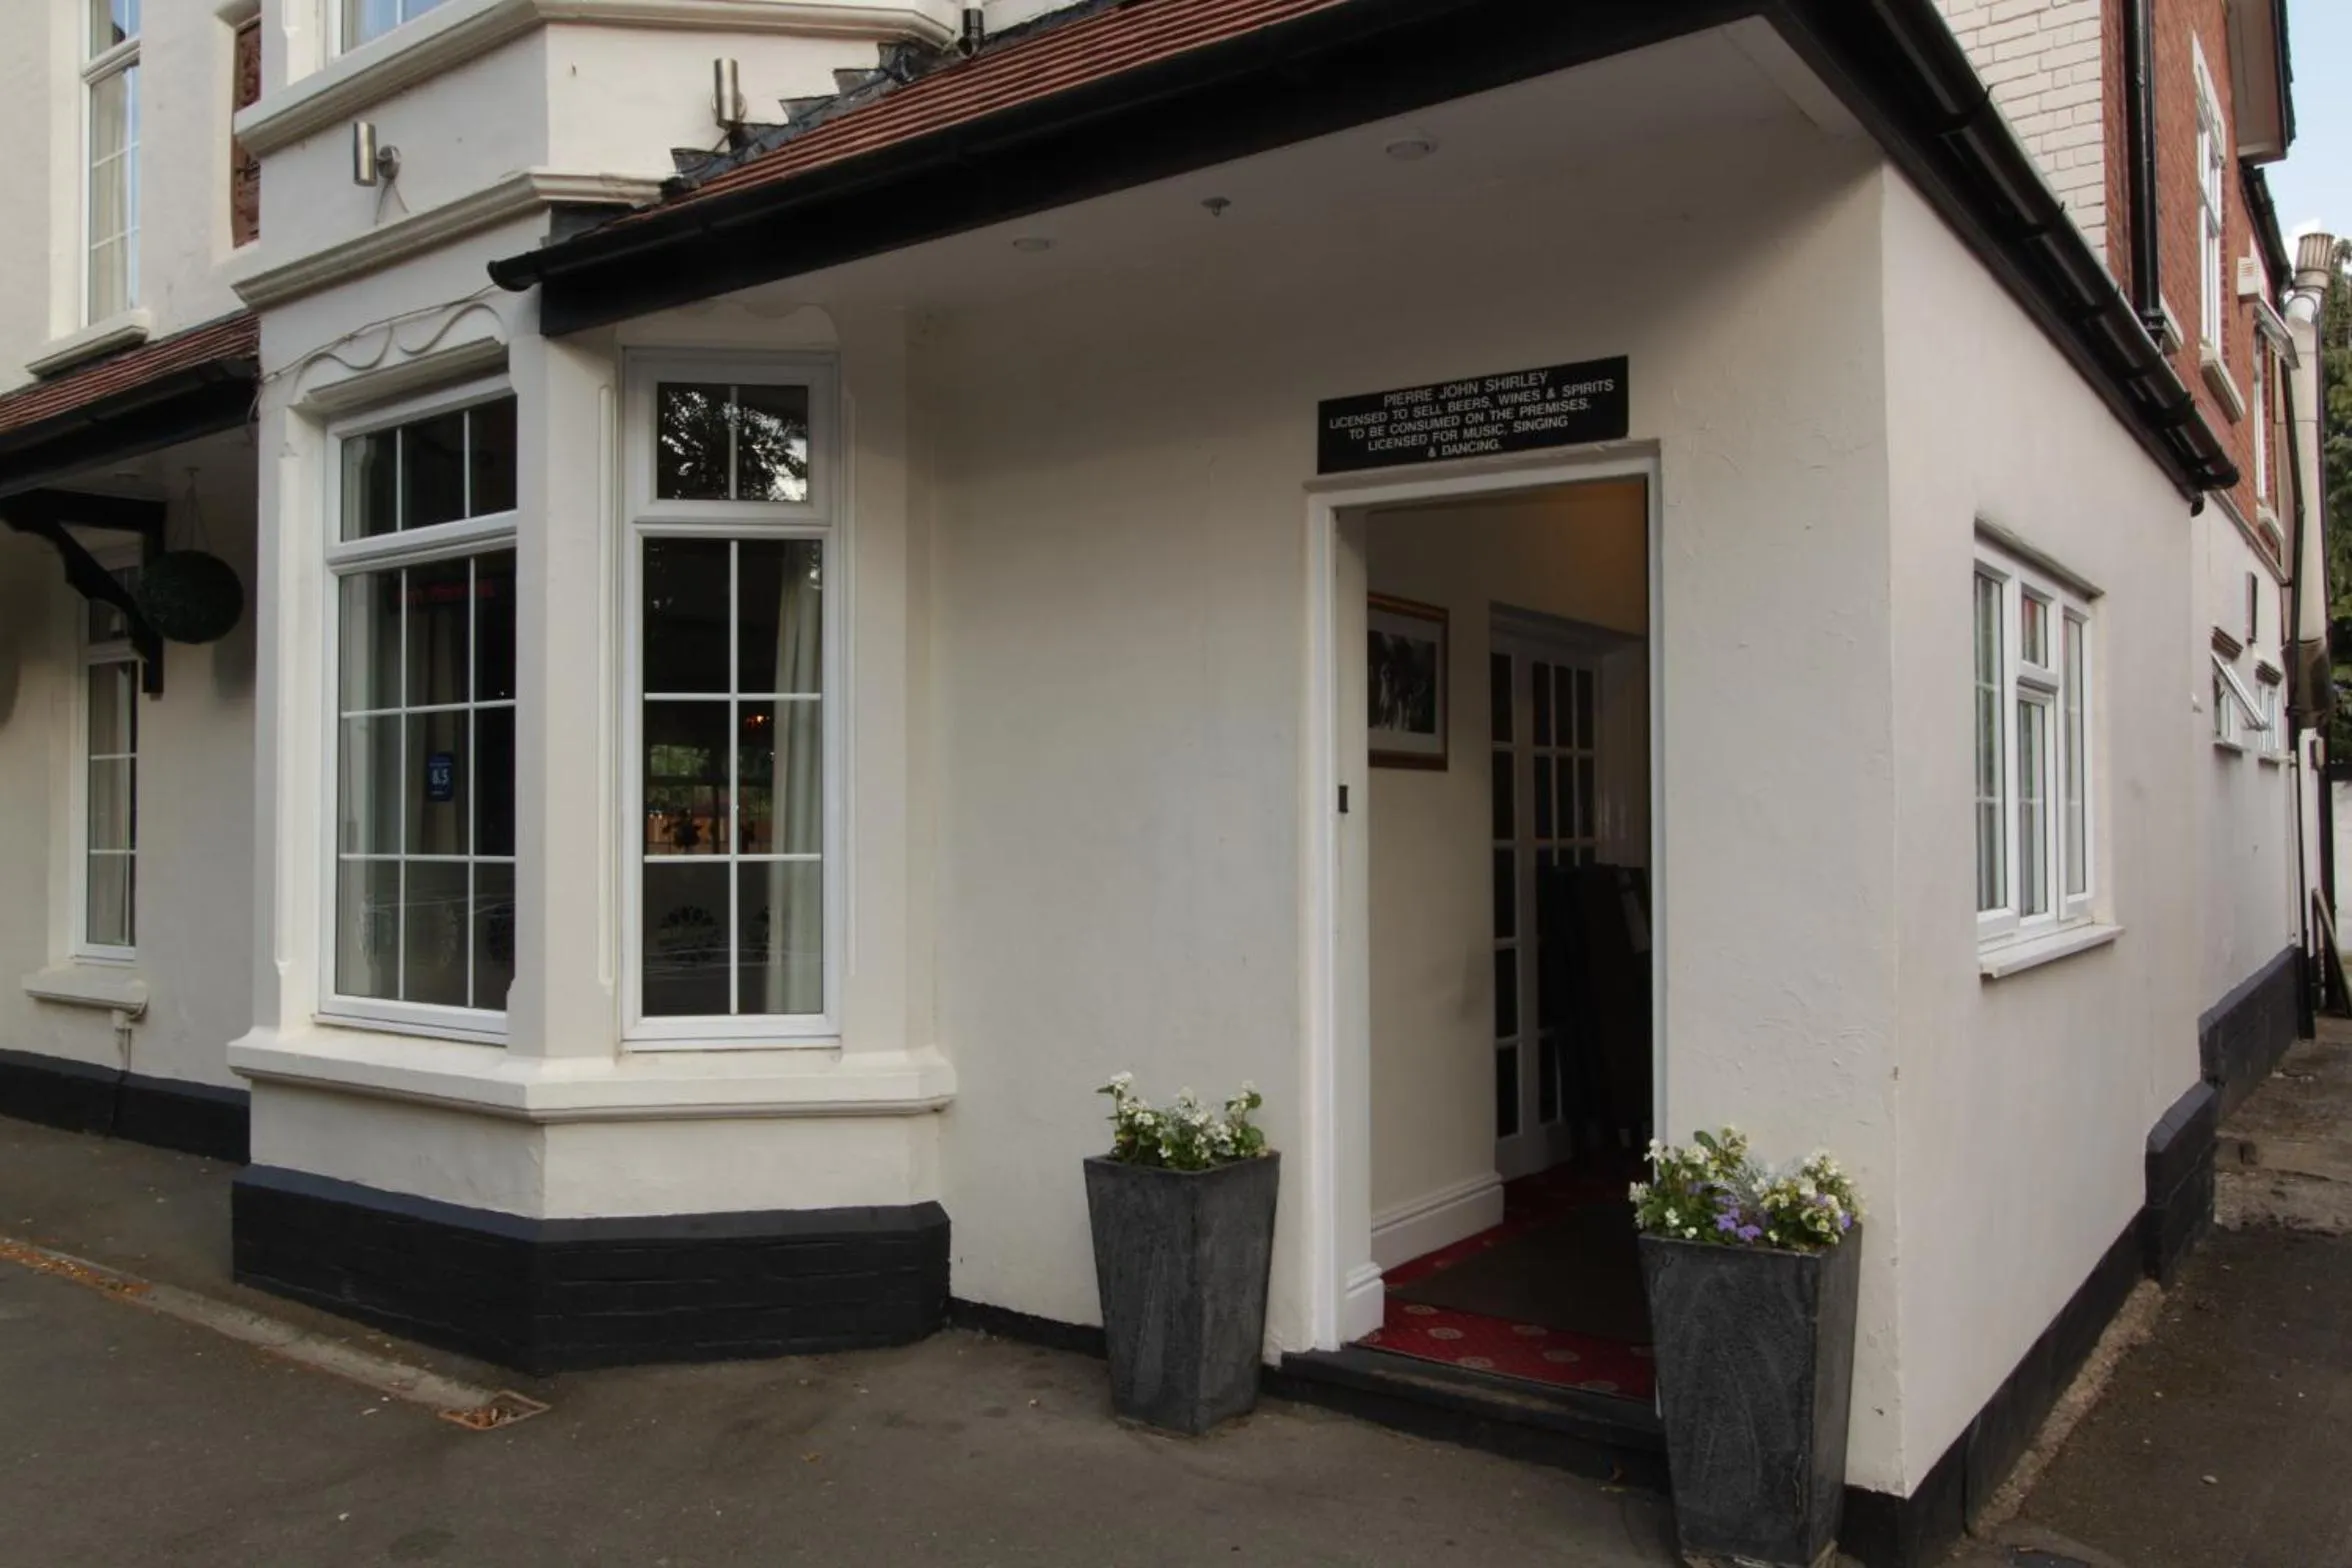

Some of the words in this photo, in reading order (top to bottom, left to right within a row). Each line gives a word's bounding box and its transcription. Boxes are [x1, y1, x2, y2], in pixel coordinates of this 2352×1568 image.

[1329, 411, 1388, 429] LICENSED
[1392, 408, 1408, 420] TO
[1413, 404, 1443, 418] SELL
[1498, 389, 1541, 406] WINES
[1546, 387, 1556, 400] &
[1562, 379, 1614, 397] SPIRITS
[1384, 388, 1433, 407] PIERRE
[1439, 381, 1479, 400] JOHN
[1484, 370, 1548, 392] SHIRLEY
[1349, 428, 1364, 440] TO
[1369, 425, 1385, 437] BE
[1390, 415, 1460, 434] CONSUMED
[1465, 412, 1484, 424] ON
[1489, 407, 1515, 421] THE
[1367, 434, 1428, 451] LICENSED
[1433, 429, 1458, 443] FOR
[1513, 415, 1568, 434] SINGING
[1427, 447, 1437, 458] &
